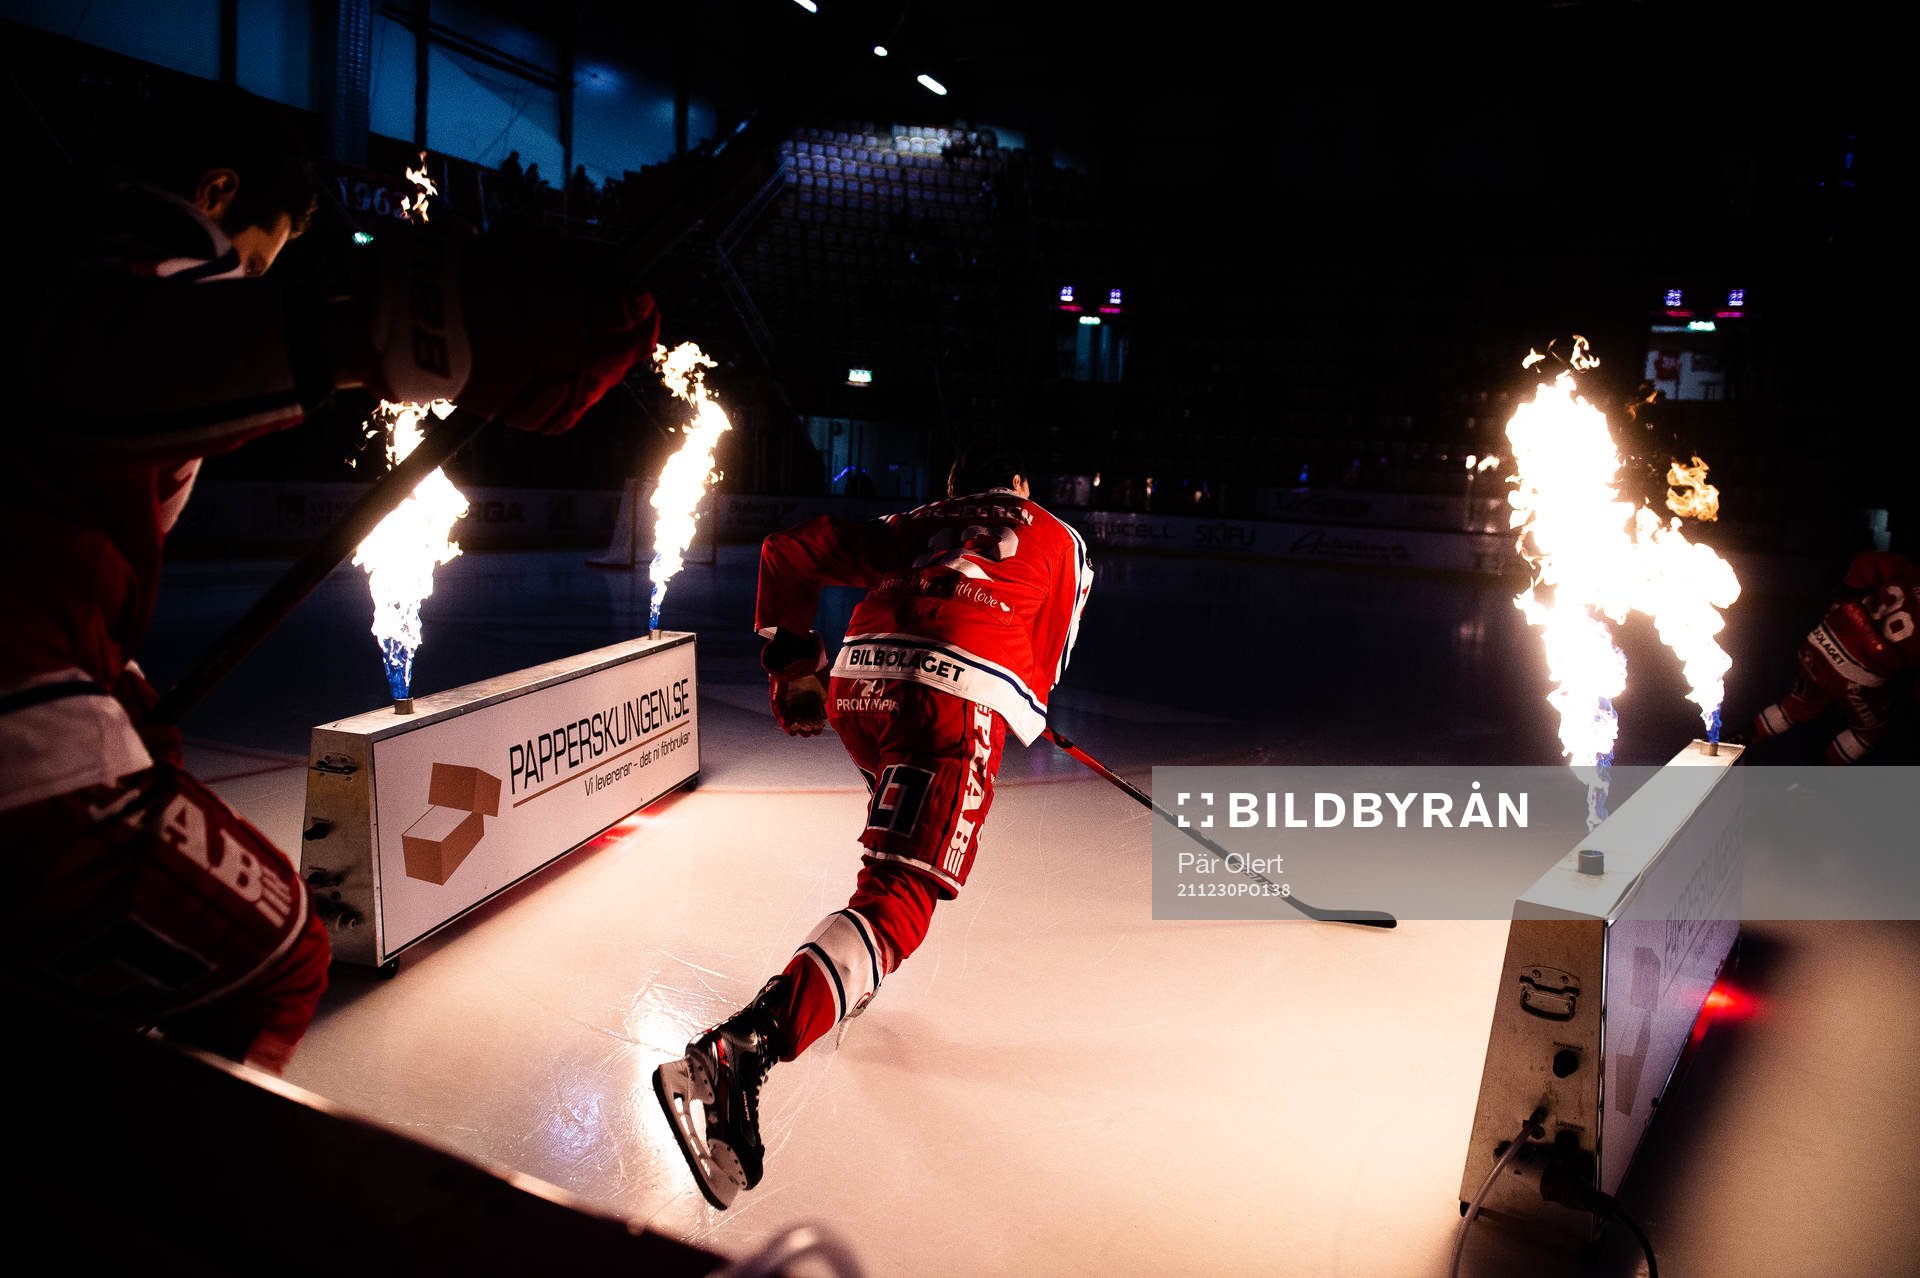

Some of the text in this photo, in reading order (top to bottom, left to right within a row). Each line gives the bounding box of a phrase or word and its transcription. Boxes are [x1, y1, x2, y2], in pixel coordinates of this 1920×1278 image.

[973, 587, 998, 609] love
[849, 650, 965, 682] BILBOLAGET
[509, 678, 690, 795] PAPPERSKUNGEN.SE
[584, 777, 595, 796] Vi
[595, 761, 633, 792] levererar
[639, 748, 652, 769] det
[653, 743, 661, 761] ni
